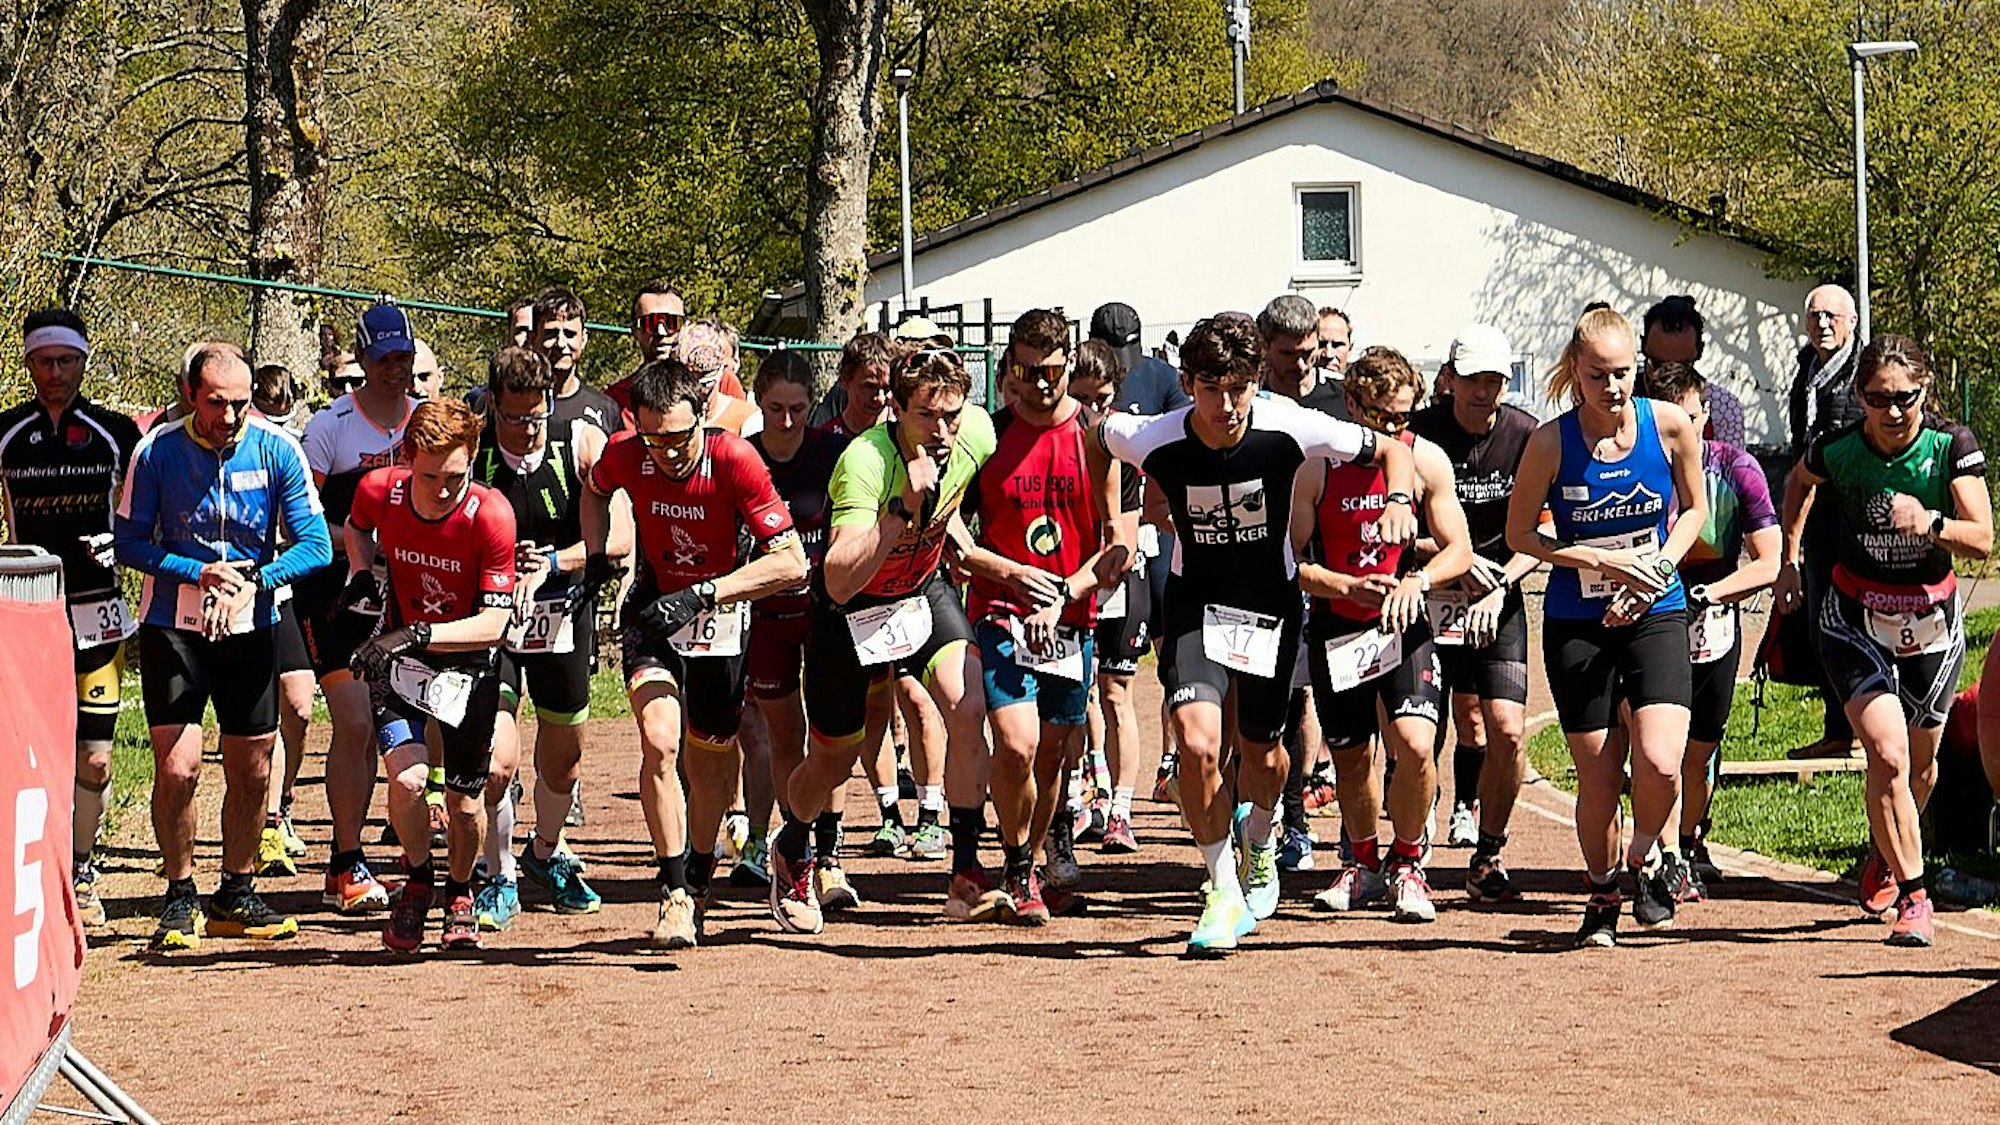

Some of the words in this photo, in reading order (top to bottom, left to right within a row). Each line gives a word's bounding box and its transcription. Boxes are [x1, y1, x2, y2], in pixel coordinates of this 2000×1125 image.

[1013, 475, 1041, 493] TUS
[652, 501, 705, 520] FROHN
[1341, 494, 1386, 512] SCHEL
[1572, 499, 1663, 522] SKI-KELLER
[1235, 526, 1269, 543] KER
[394, 547, 462, 574] HOLDER
[97, 603, 122, 629] 33
[523, 615, 550, 638] 20
[1440, 604, 1466, 628] 26
[689, 616, 716, 642] 16
[880, 619, 909, 646] 31
[1229, 624, 1255, 653] 17
[1900, 627, 1915, 646] 8
[1354, 643, 1382, 669] 22
[417, 678, 443, 706] 18
